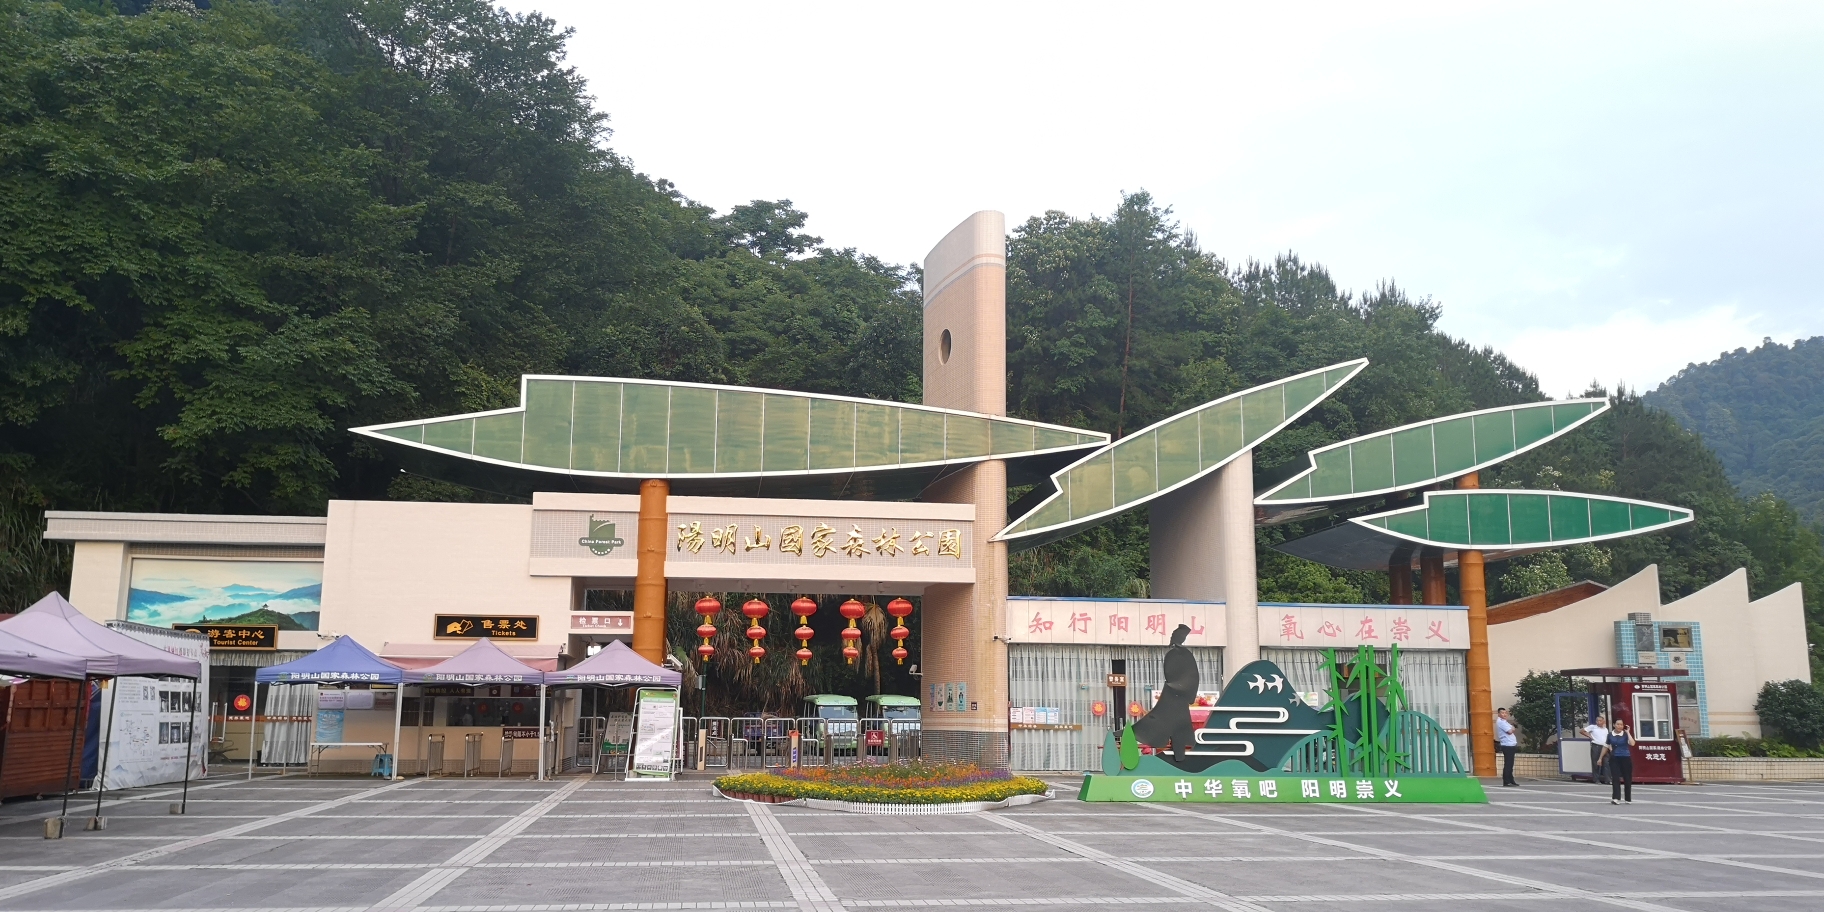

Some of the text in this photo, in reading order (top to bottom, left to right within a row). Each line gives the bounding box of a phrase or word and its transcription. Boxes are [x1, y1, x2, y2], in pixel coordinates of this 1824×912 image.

[677, 520, 961, 559] 陽明山國家森林公園
[481, 619, 528, 630] 售票处
[1028, 611, 1205, 636] 知行阳明山
[1280, 613, 1449, 643] 氧心在崇义
[207, 629, 265, 639] 游客中心
[290, 672, 380, 680] 阳明山国家森林公园
[436, 673, 523, 681] 阳明山国家森林公园
[577, 674, 661, 682] 阳明山国家森林公园
[1174, 778, 1403, 799] 中华氧吧 阳明崇义
